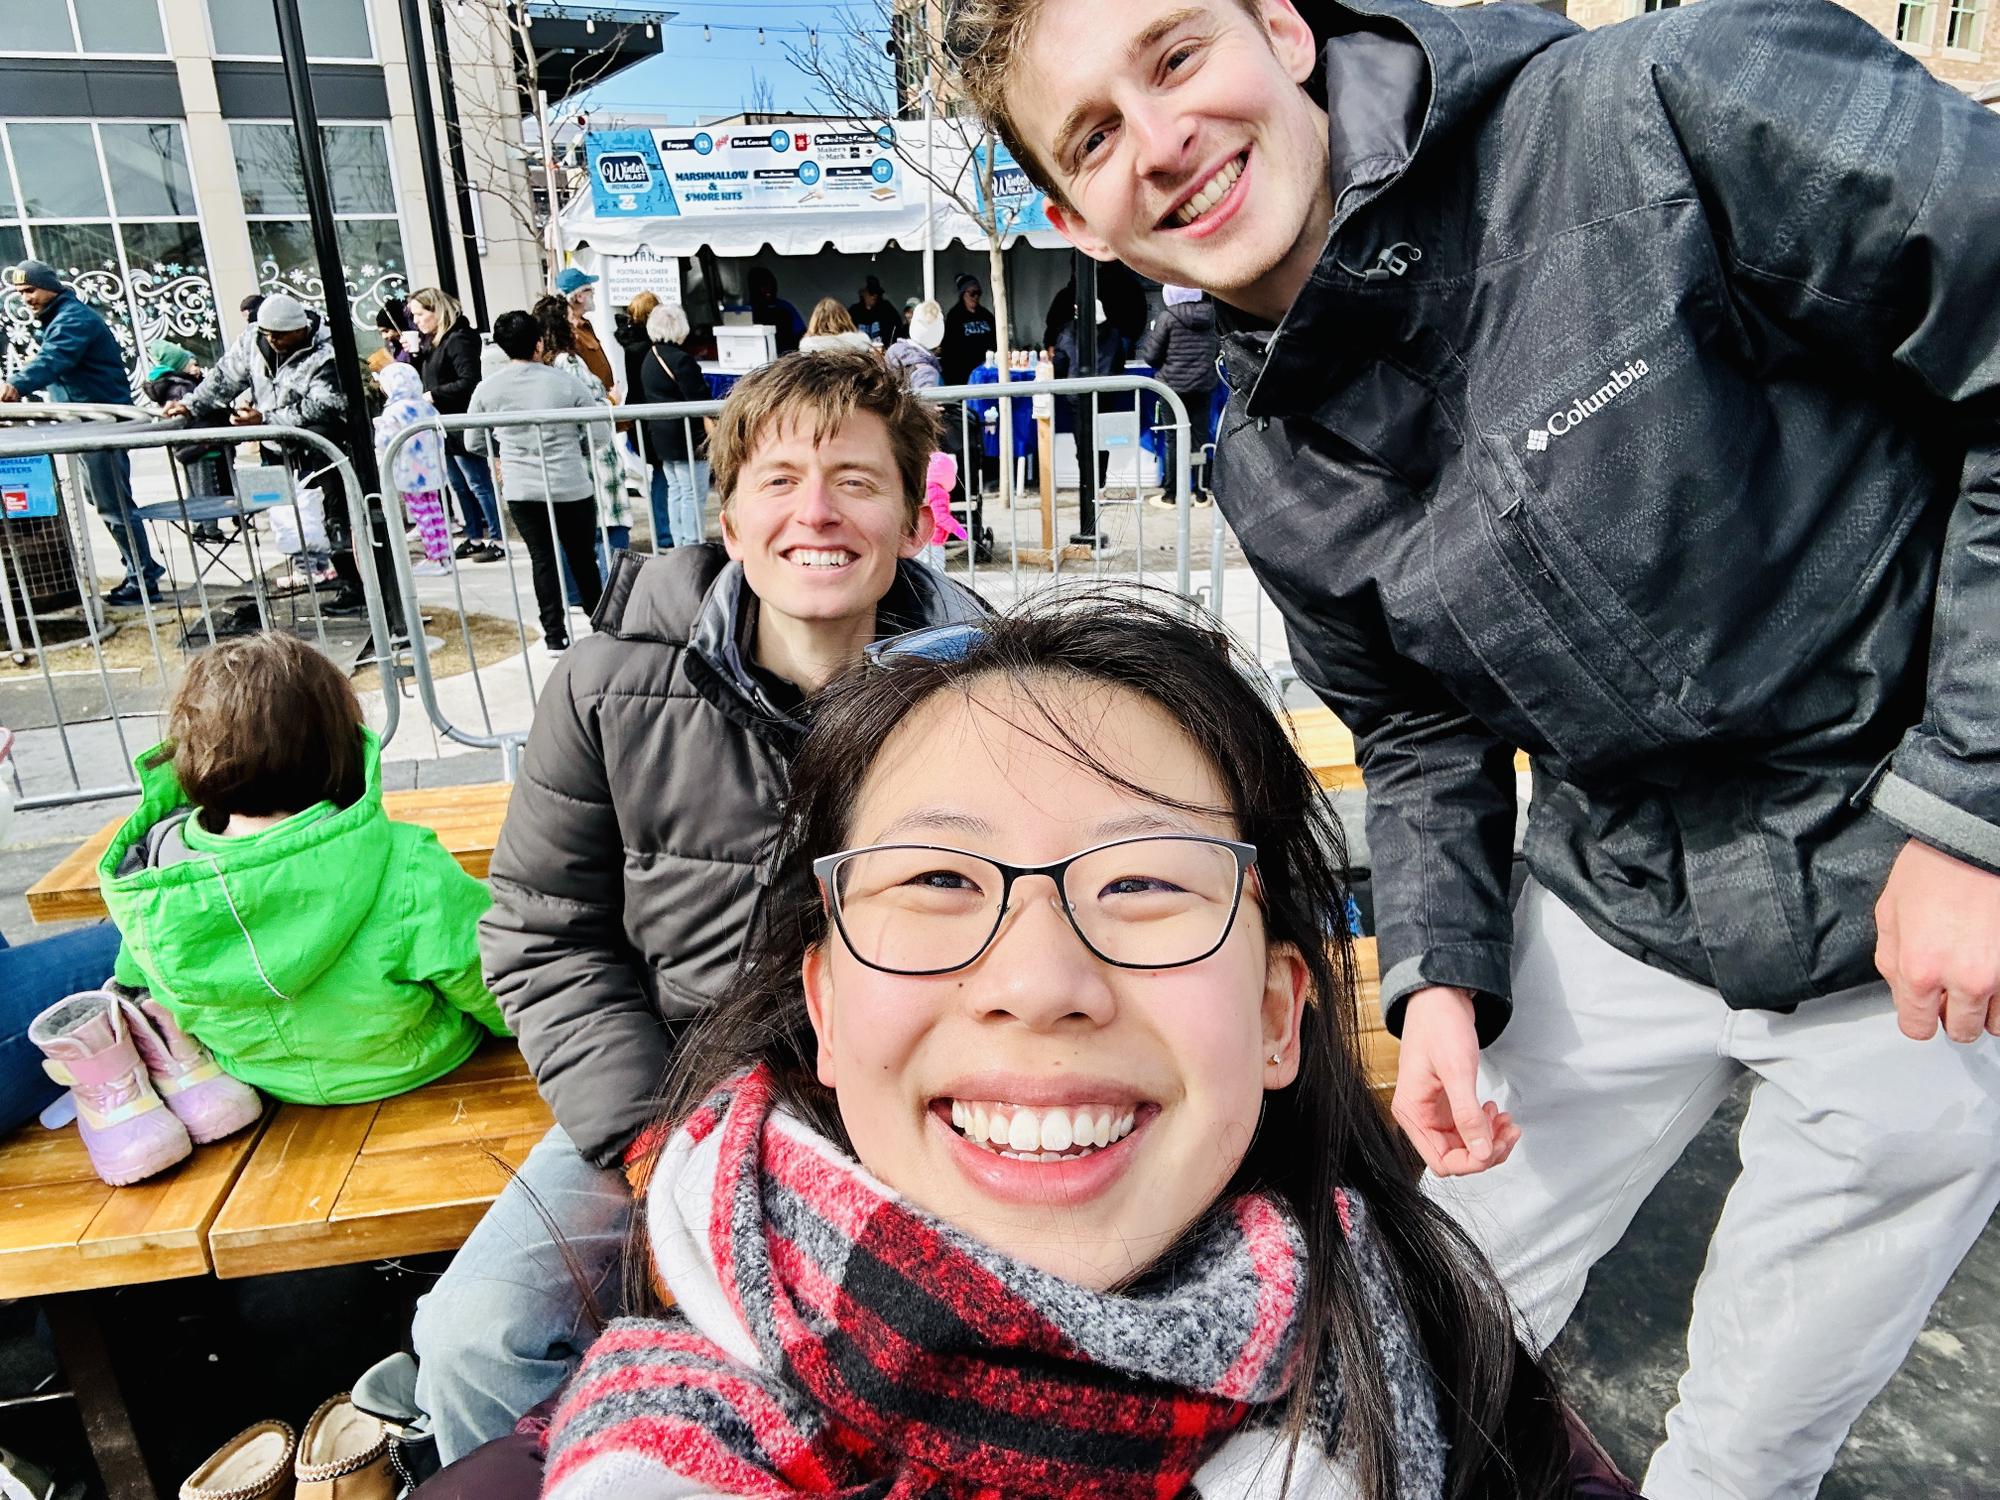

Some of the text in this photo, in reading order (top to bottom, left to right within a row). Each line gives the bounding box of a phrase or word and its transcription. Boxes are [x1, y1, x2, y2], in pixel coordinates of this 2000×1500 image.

[733, 139, 747, 147] Hot
[748, 138, 769, 146] Cocoa
[602, 161, 646, 182] Winter
[624, 173, 646, 181] BLAST
[675, 170, 749, 181] MARSHMALLOW
[708, 182, 718, 191] &
[684, 191, 743, 202] S'MORE KITS
[1547, 359, 1650, 435] Columbia
